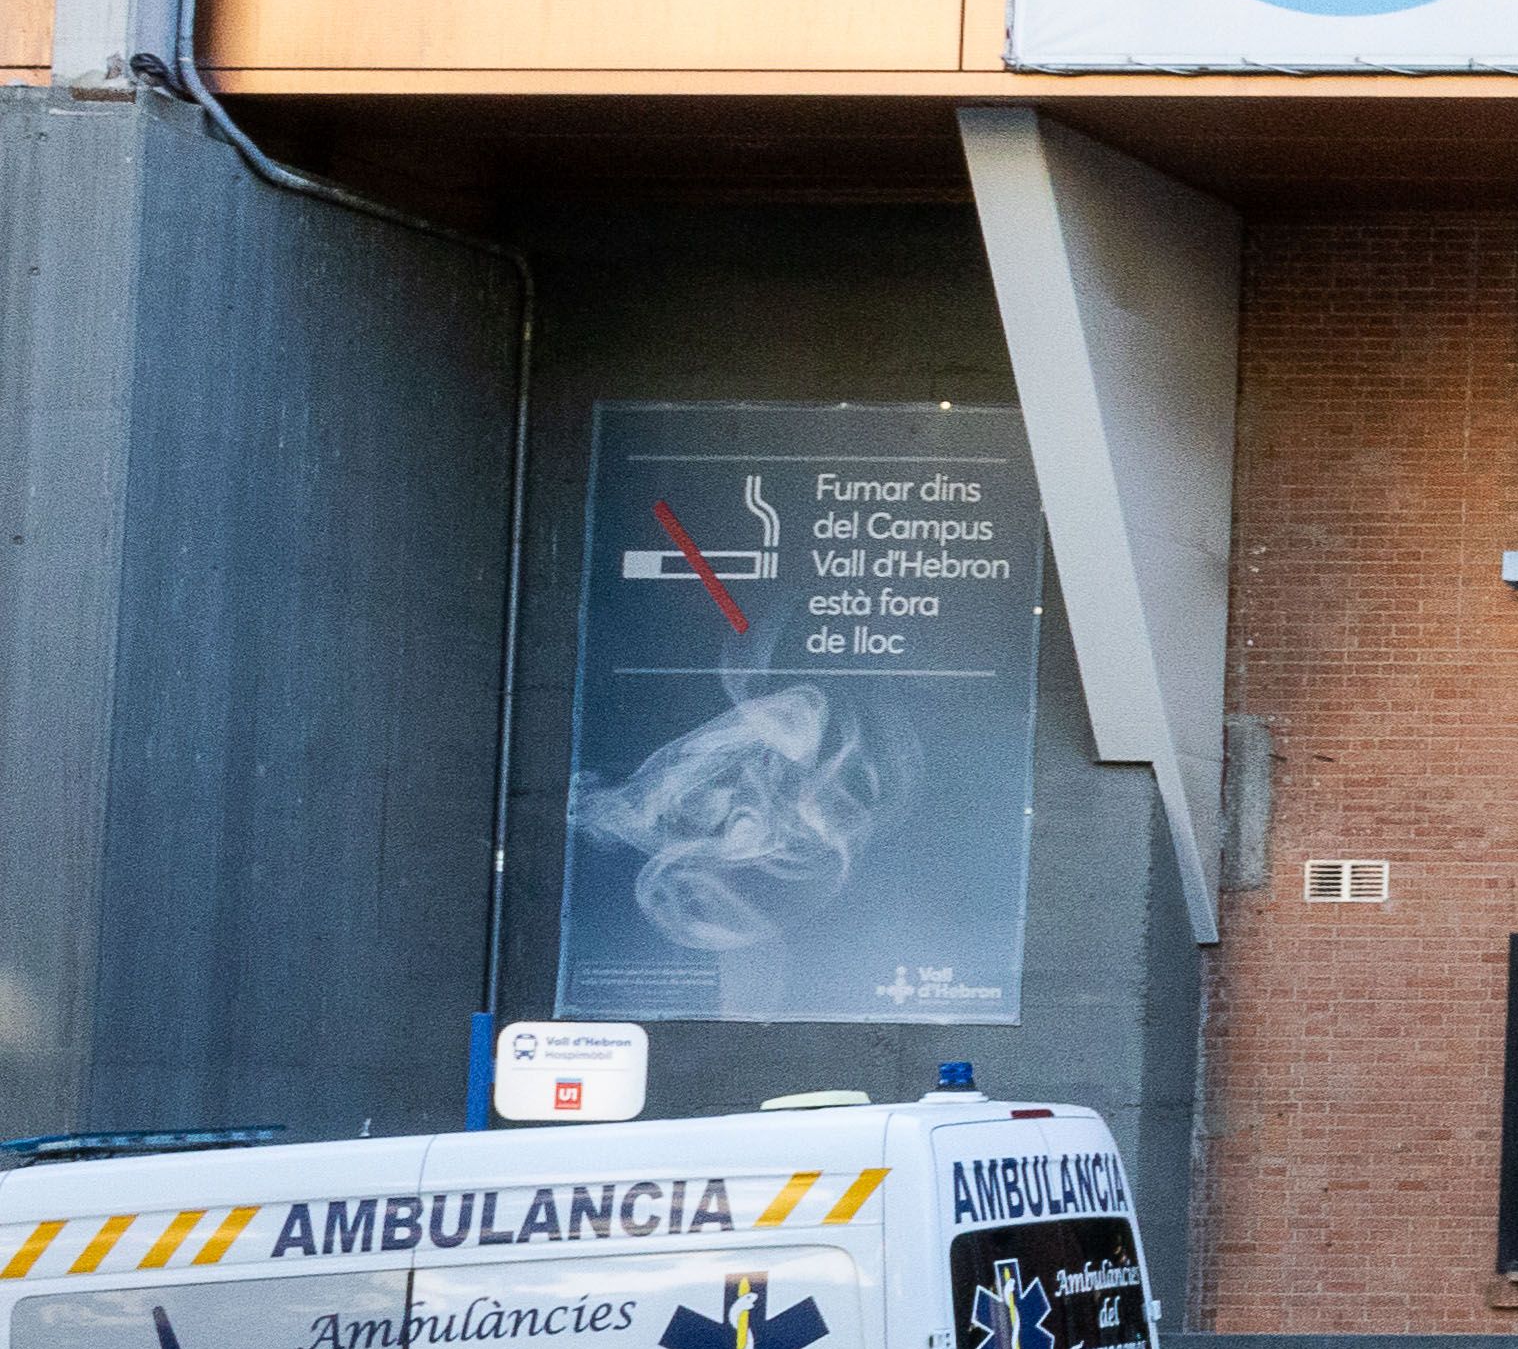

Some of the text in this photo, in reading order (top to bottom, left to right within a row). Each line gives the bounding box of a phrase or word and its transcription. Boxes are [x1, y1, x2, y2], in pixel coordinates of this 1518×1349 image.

[816, 473, 982, 503] Fumar dins
[813, 511, 993, 546] del Campus
[812, 549, 1010, 579] Vall d'Hebron
[808, 587, 940, 617] està fora
[806, 625, 906, 654] de lloc
[919, 967, 953, 983] Vall
[546, 1036, 570, 1047] Vall
[953, 1152, 1129, 1224] AMBULANCIA
[270, 1178, 735, 1259] AMBULANCIA
[1099, 1295, 1121, 1328] del
